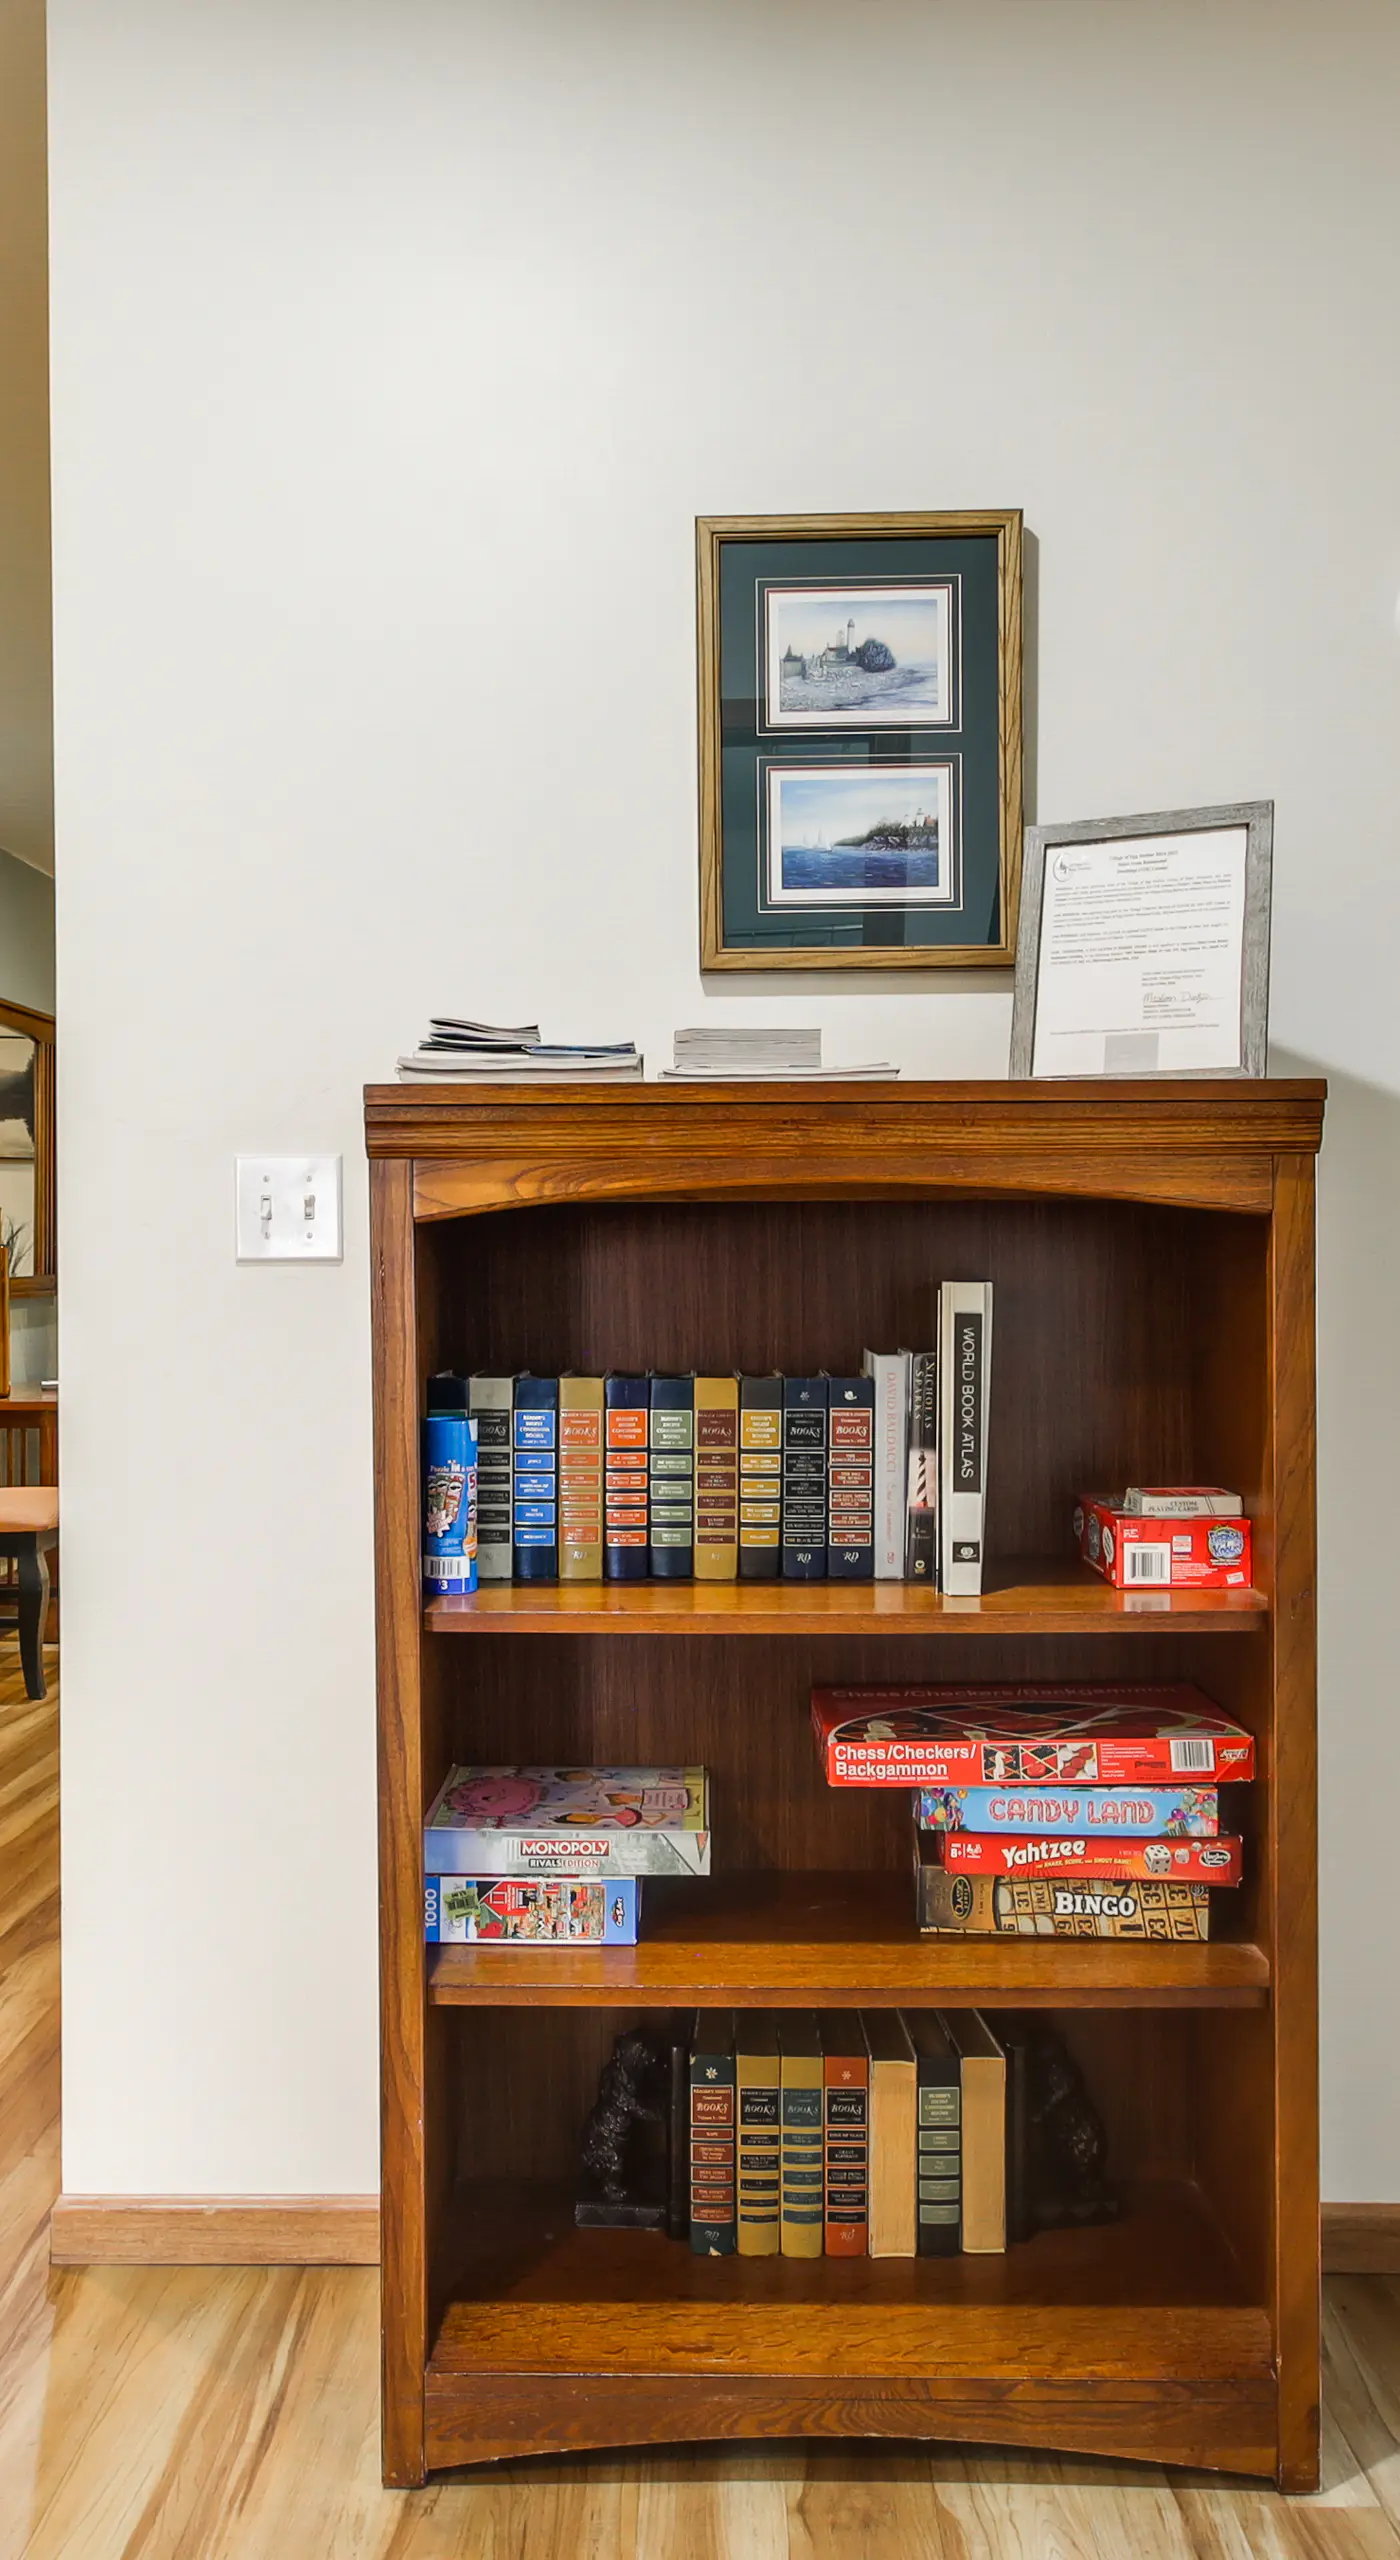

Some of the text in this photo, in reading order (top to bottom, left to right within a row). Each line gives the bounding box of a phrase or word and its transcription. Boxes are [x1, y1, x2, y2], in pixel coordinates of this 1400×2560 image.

[886, 1372, 897, 1410] DAVID
[914, 1369, 925, 1420] SPARKS
[925, 1358, 935, 1428] NICHOLAS
[961, 1327, 975, 1478] WORLD BOOK ATLAS
[564, 1427, 597, 1438] BOOKS
[702, 1427, 732, 1437] BOOKS
[790, 1427, 821, 1438] BOOKS
[836, 1426, 867, 1437] BOOKS
[886, 1413, 897, 1473] BALDACCI
[835, 1744, 976, 1760] Chess/Checkers/
[836, 1762, 948, 1780] Backgammon
[989, 1798, 1154, 1824] CANDY LAND
[522, 1842, 608, 1854] MONOPOLY
[1001, 1840, 1086, 1868] Yahtzee
[1016, 1891, 1030, 1908] 31
[1055, 1892, 1135, 1916] BINGO
[425, 1889, 437, 1928] 1000
[1174, 1919, 1195, 1938] 17
[697, 2102, 728, 2114] BOOKS
[744, 2104, 776, 2115] BOOKS
[787, 2105, 819, 2116] BOOKS
[831, 2104, 864, 2115] BOOKS
